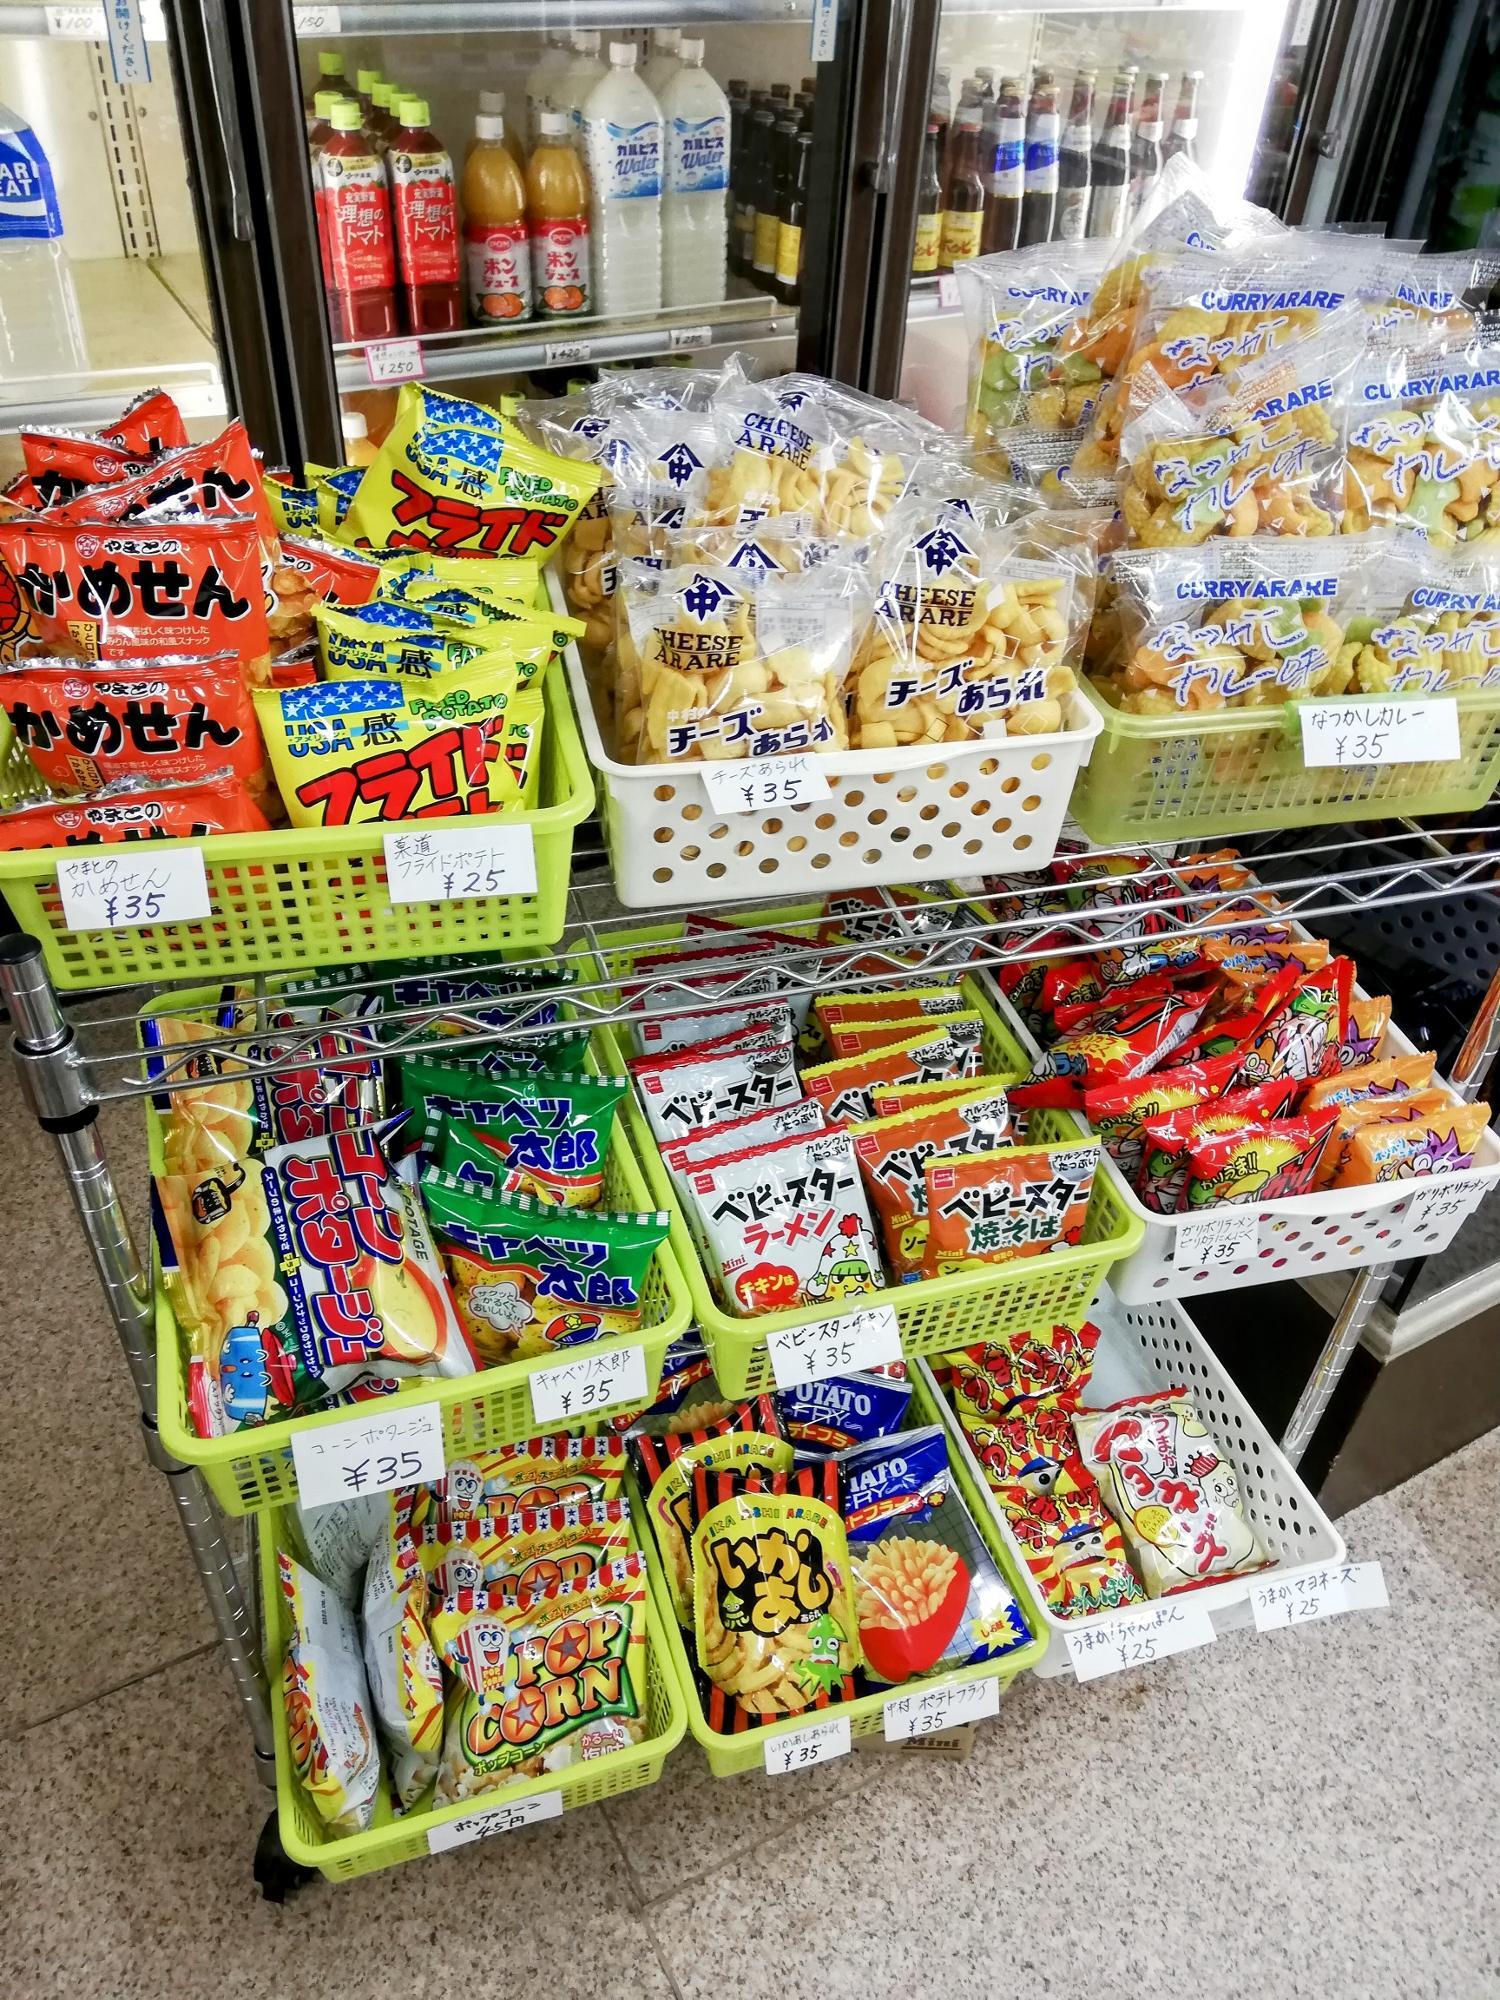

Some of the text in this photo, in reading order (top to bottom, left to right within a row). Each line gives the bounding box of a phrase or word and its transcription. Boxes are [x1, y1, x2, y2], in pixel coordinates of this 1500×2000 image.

[616, 142, 659, 157] カルピス
[682, 136, 725, 151] カルピス
[614, 156, 660, 176] Water
[680, 150, 726, 170] Water
[340, 204, 385, 227] 理想の
[408, 200, 452, 223] 理想の
[345, 224, 385, 246] トマト
[414, 220, 451, 242] トマト
[379, 361, 415, 375] ¥250
[743, 411, 814, 453] CHEESE
[734, 430, 810, 472] ARARE
[390, 467, 569, 555] フライド
[103, 539, 181, 555] やまとの
[18, 559, 252, 621] かめせん
[396, 648, 434, 679] 感
[653, 650, 742, 672] ARARE
[95, 682, 167, 696] やまとの
[7, 701, 243, 756] かめせん
[363, 712, 404, 747] 感
[1311, 706, 1426, 728] なつかしカレー
[1336, 732, 1390, 763] ¥35
[294, 714, 505, 827] フライド
[711, 757, 810, 785] チーズあられ
[740, 779, 802, 808] ¥35
[86, 803, 162, 823] やまとの
[65, 859, 119, 879] やまとの
[398, 847, 505, 879] フライドポテト
[71, 869, 173, 899] かめせん
[443, 868, 506, 899] ¥25
[104, 892, 167, 926] ¥35
[424, 1094, 573, 1130] キャベツ
[774, 1100, 820, 1124] カルシウム
[782, 1110, 821, 1132] たっぷり
[964, 1098, 1008, 1117] カルシウム
[504, 1130, 600, 1171] 太郎
[804, 1135, 851, 1154] カルシウム
[812, 1145, 850, 1162] たっぷり
[1058, 1157, 1096, 1172] たっぷり
[1200, 1151, 1259, 1191] かりうま!!
[711, 1167, 856, 1222] ベビースター
[942, 1177, 1090, 1220] ベビースター
[1421, 1199, 1466, 1220] ¥35
[438, 1221, 610, 1268] キャベツ
[743, 1207, 837, 1256] ラーメン
[970, 1214, 1062, 1251] 焼そば
[1200, 1241, 1241, 1265] ¥35
[536, 1262, 639, 1306] 太郎
[535, 1350, 632, 1391] キャベツ太郎
[803, 1341, 856, 1375] ¥35
[561, 1378, 614, 1415] ¥35
[310, 1415, 436, 1455] コーンポタージュ
[1150, 1412, 1178, 1468] うまか
[342, 1450, 423, 1492] ¥35
[709, 1516, 737, 1537] IKA
[1285, 1597, 1321, 1624] ¥25
[515, 1611, 624, 1688] POP
[1116, 1636, 1158, 1670] ¥25
[466, 1658, 624, 1756] CORN
[917, 1680, 990, 1712] ポテトフライ
[908, 1711, 947, 1736] ¥35
[473, 1742, 547, 1778] ポップコーン
[784, 1744, 822, 1770] ¥35
[454, 1801, 541, 1833] ポップコーン
